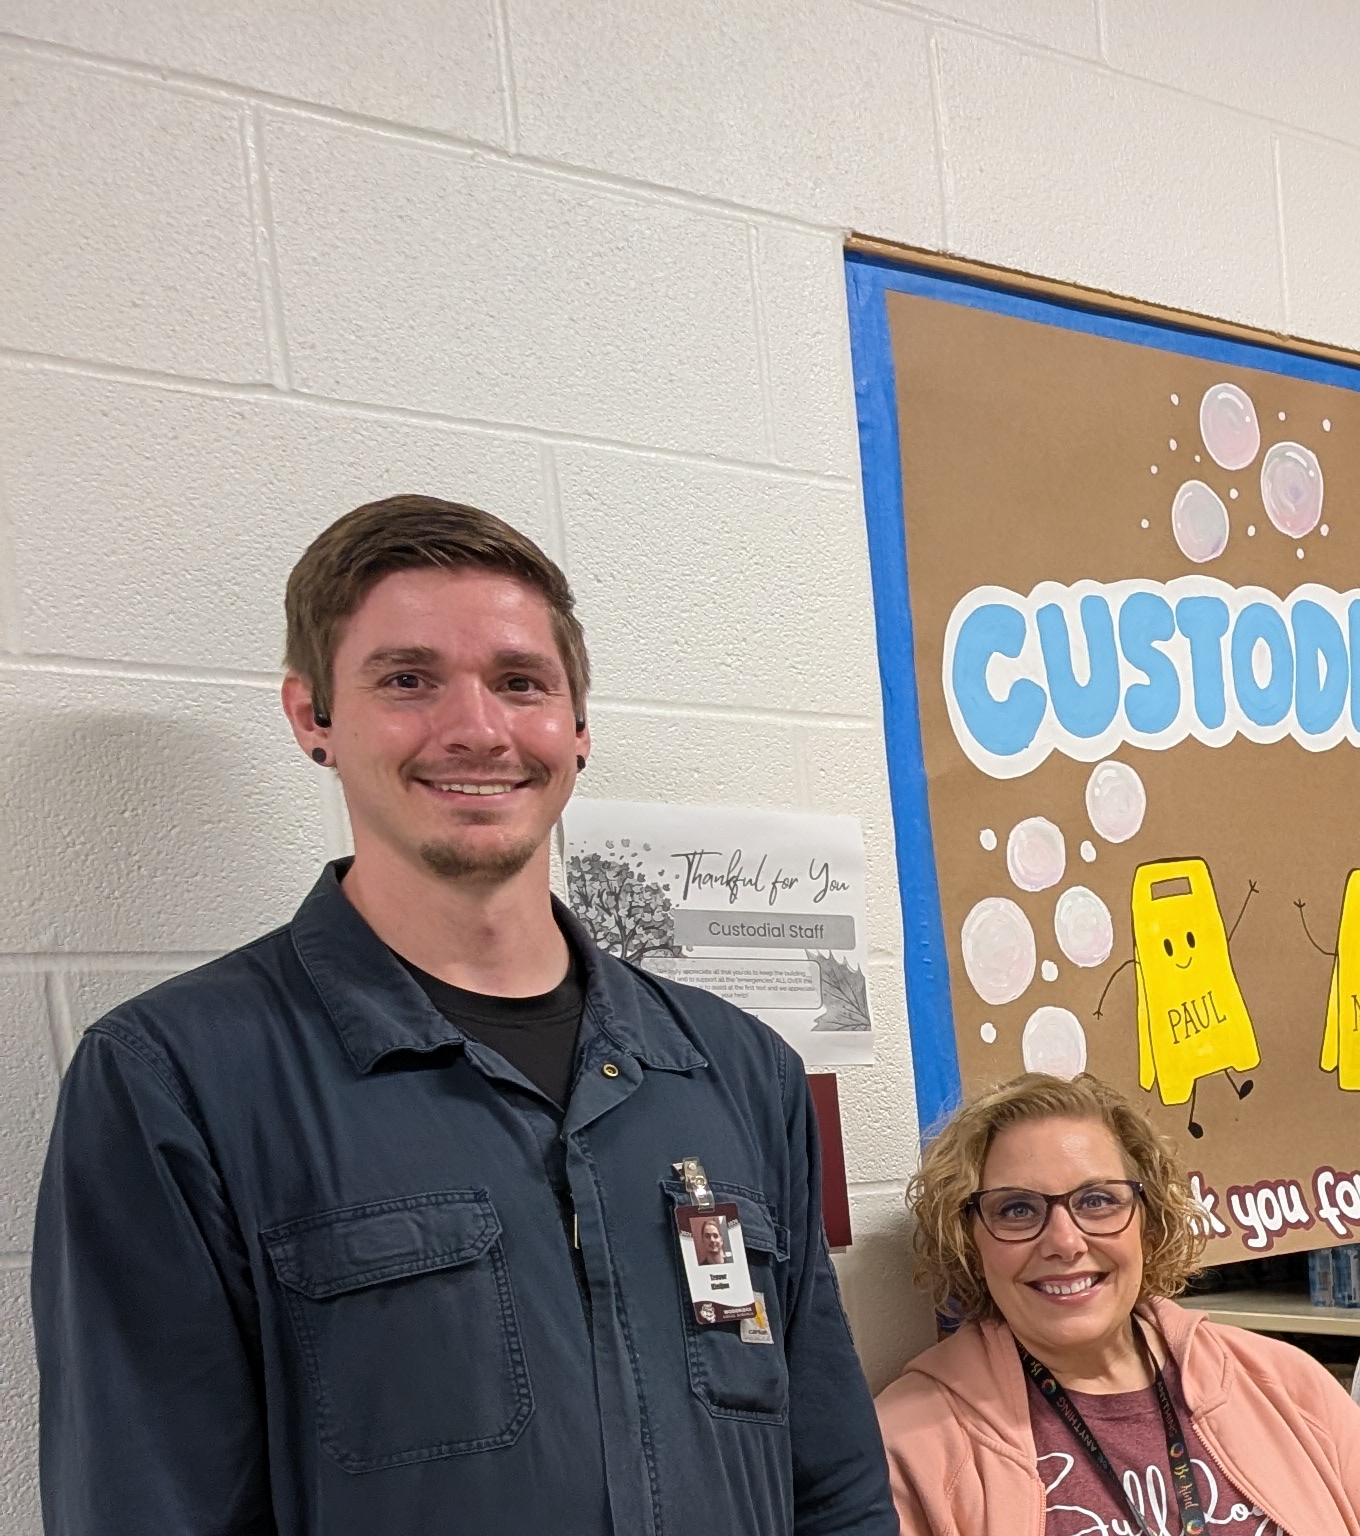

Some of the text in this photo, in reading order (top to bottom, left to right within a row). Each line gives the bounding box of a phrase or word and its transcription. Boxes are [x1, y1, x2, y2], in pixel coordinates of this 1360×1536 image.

[671, 849, 850, 905] Thankful for You
[708, 921, 825, 940] Custodial Staff
[1166, 991, 1227, 1043] PAUL
[1230, 1183, 1311, 1248] you
